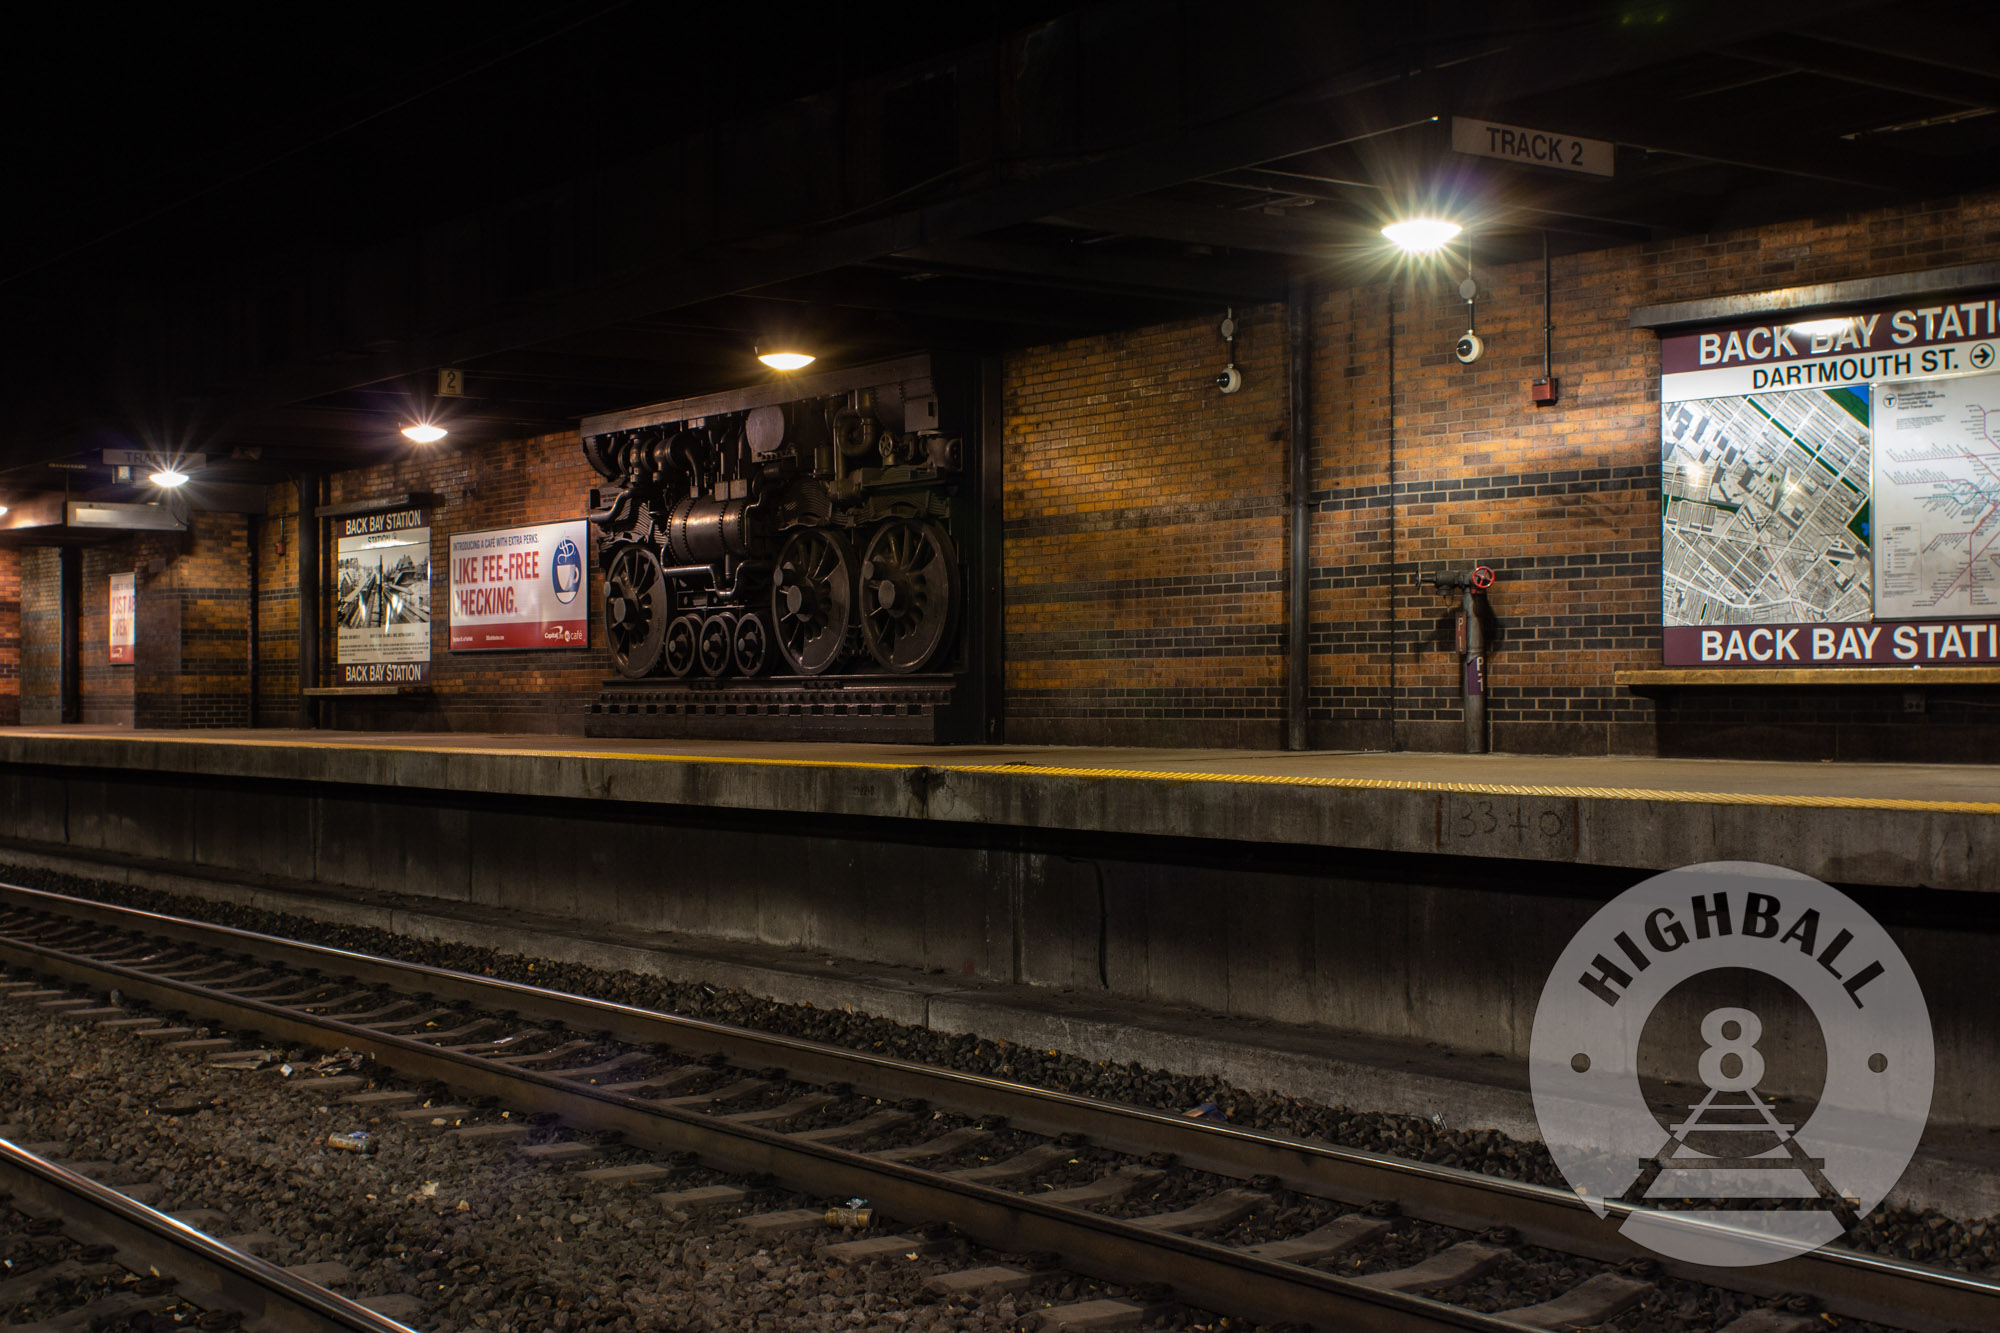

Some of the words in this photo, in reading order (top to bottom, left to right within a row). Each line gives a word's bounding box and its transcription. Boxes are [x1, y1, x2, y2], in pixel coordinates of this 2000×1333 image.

[1486, 126, 1563, 163] TRACK
[1570, 142, 1584, 166] 2
[1699, 326, 1798, 366] BACK
[1891, 300, 2000, 344] STATI
[447, 370, 456, 389] 2
[1752, 353, 1911, 390] DARTMOUTH
[1920, 348, 1959, 373] ST.
[345, 517, 368, 536] BACK
[370, 514, 385, 532] BAY
[386, 509, 422, 530] STATION
[452, 540, 480, 551] INTRODUCING
[497, 537, 507, 547] WITH
[509, 535, 522, 546] EXTRA
[452, 557, 478, 585] LIKE
[482, 551, 539, 582] FEE-FREE
[453, 586, 518, 616] CHECKING.
[1701, 629, 1800, 661] BACK
[1812, 627, 1881, 660] BAY
[1892, 624, 2000, 660] STATI
[345, 665, 368, 682] BACK
[370, 664, 385, 681] BAY
[386, 664, 421, 681] STATION
